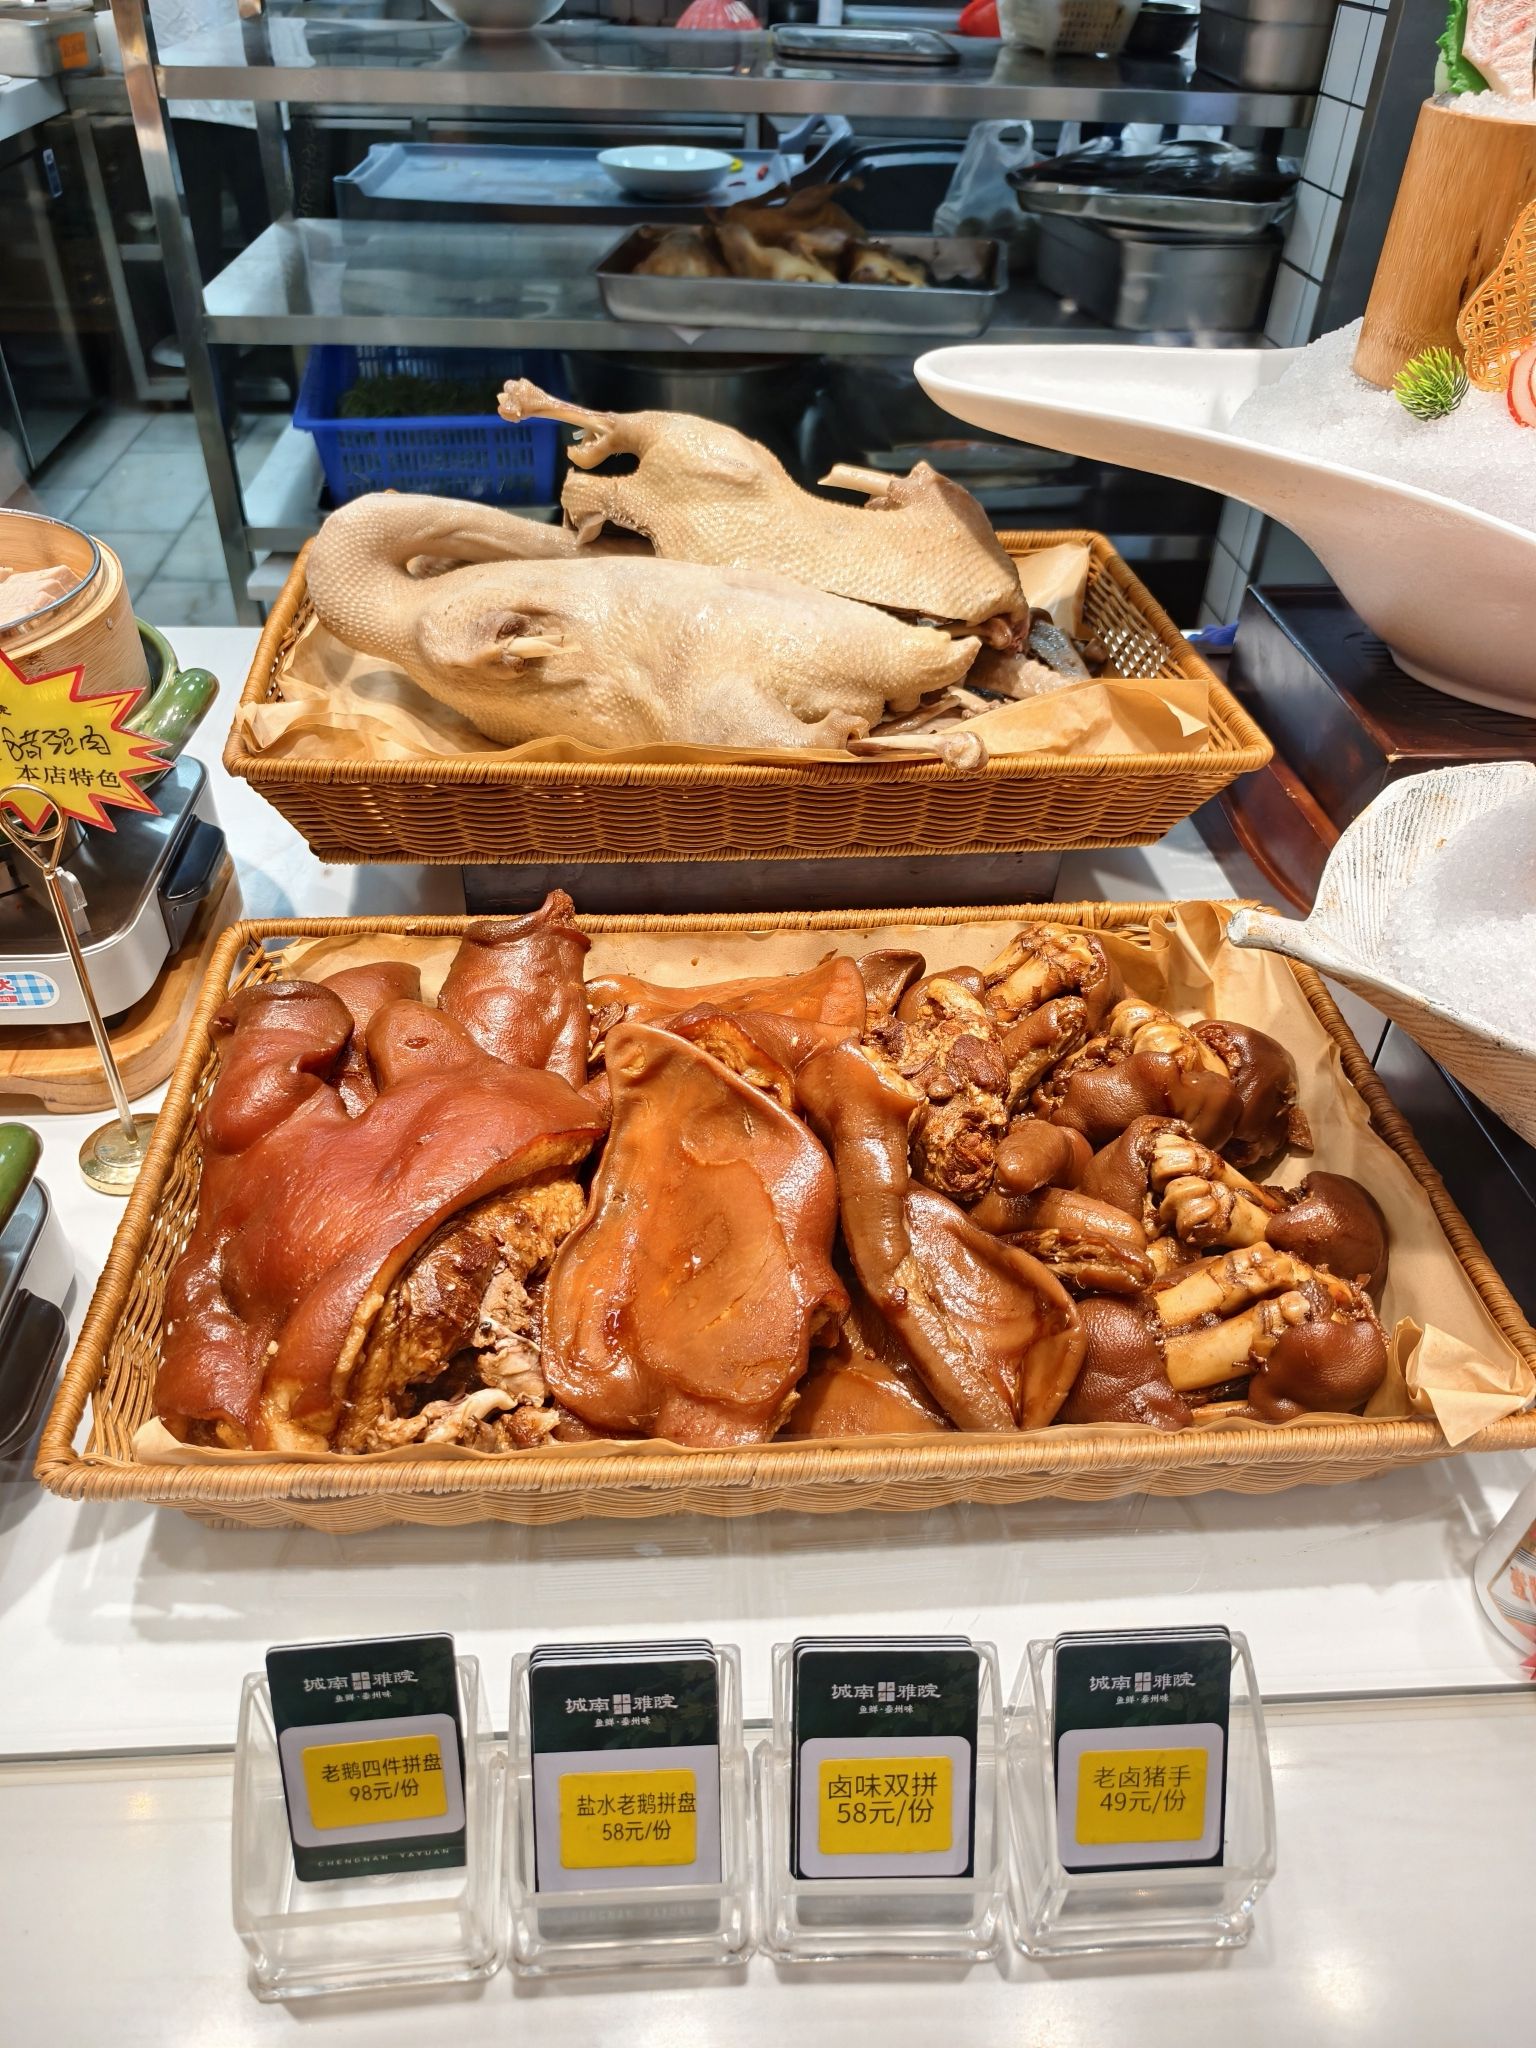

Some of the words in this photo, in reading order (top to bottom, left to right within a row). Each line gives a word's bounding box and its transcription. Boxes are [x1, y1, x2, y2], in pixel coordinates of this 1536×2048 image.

[14, 764, 121, 788] 本店特色
[321, 1753, 443, 1783] 老鹅四件拼盘
[1093, 1764, 1192, 1790] 老卤猪手
[349, 1778, 420, 1802] 98元/份
[828, 1771, 939, 1800] 卤味双拼
[576, 1791, 697, 1817] 盐水老鹅拼盘
[837, 1798, 935, 1827] 58元/份
[1100, 1789, 1187, 1815] 49元/份
[602, 1819, 672, 1842] 58元/份
[317, 1855, 389, 1868] CHENGNAN
[399, 1848, 450, 1859] YAYUAN
